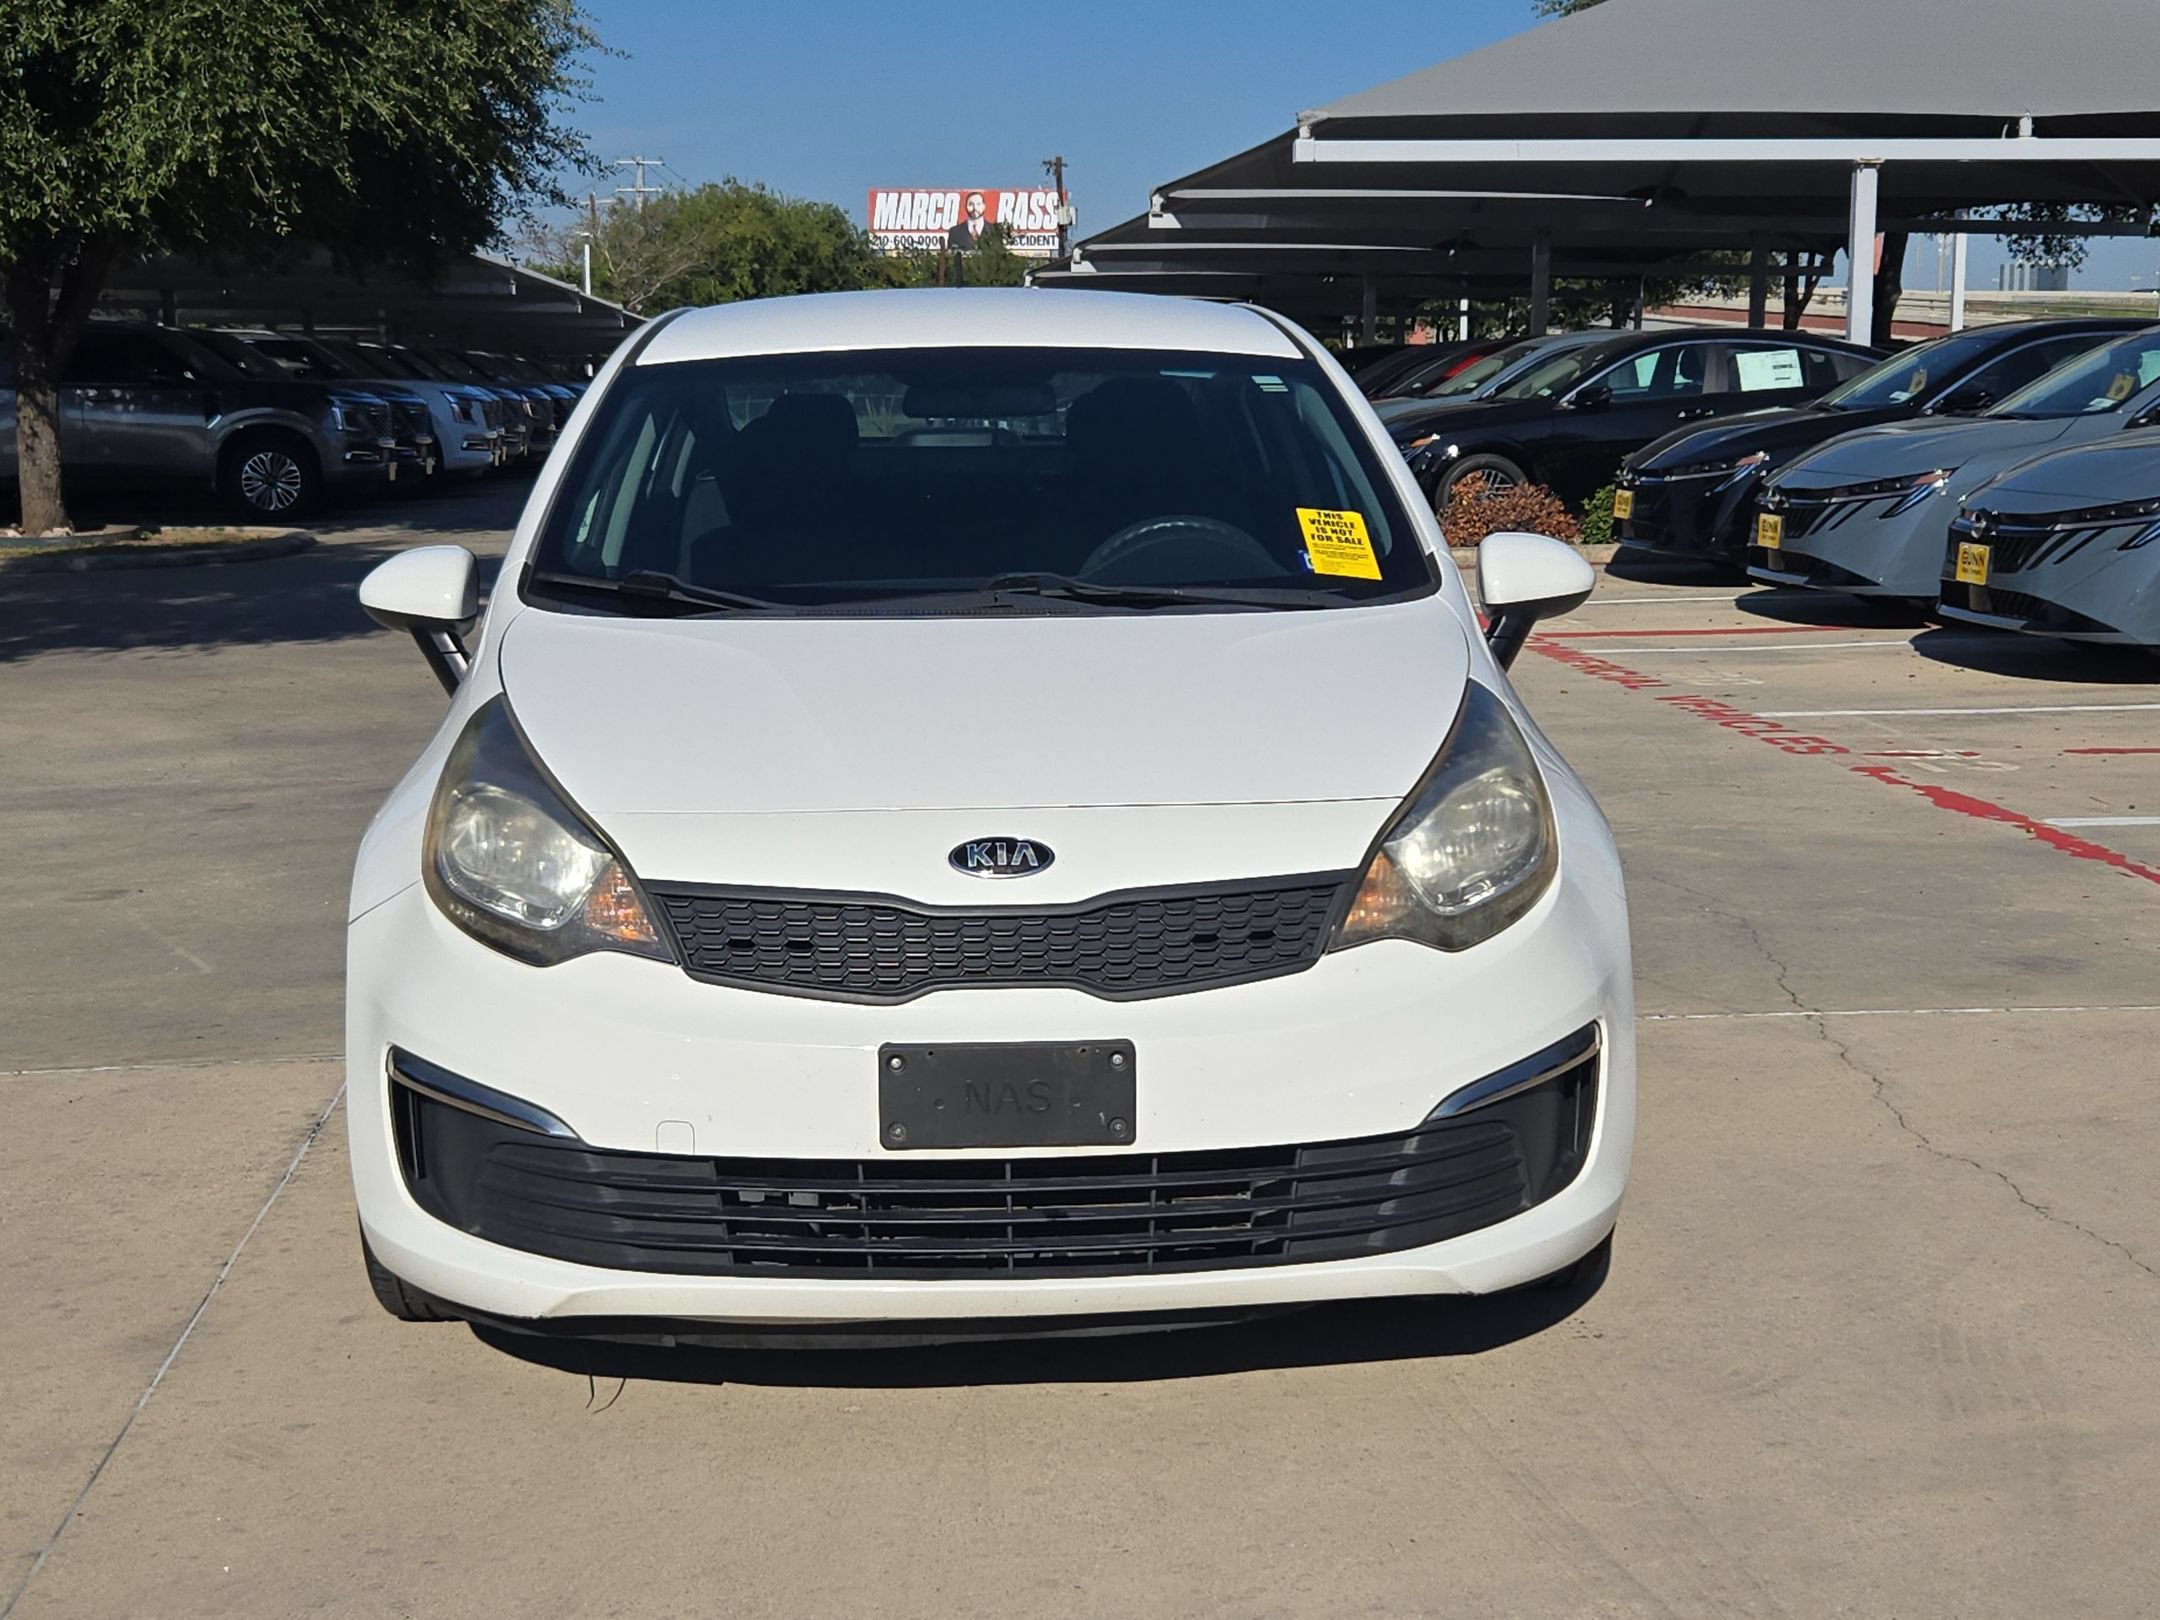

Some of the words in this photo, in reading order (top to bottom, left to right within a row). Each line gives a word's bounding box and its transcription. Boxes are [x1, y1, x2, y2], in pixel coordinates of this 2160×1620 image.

[874, 192, 960, 230] MARCO
[1308, 518, 1355, 529] VEHICLE
[1316, 511, 1344, 520] THIS
[1310, 533, 1334, 542] FOR
[1336, 536, 1363, 546] SALE
[1315, 526, 1328, 534] IS
[1330, 528, 1353, 537] NOT
[1653, 694, 1851, 755] VEHICLES
[966, 842, 1040, 868] KIA
[964, 1080, 1052, 1114] NAS
